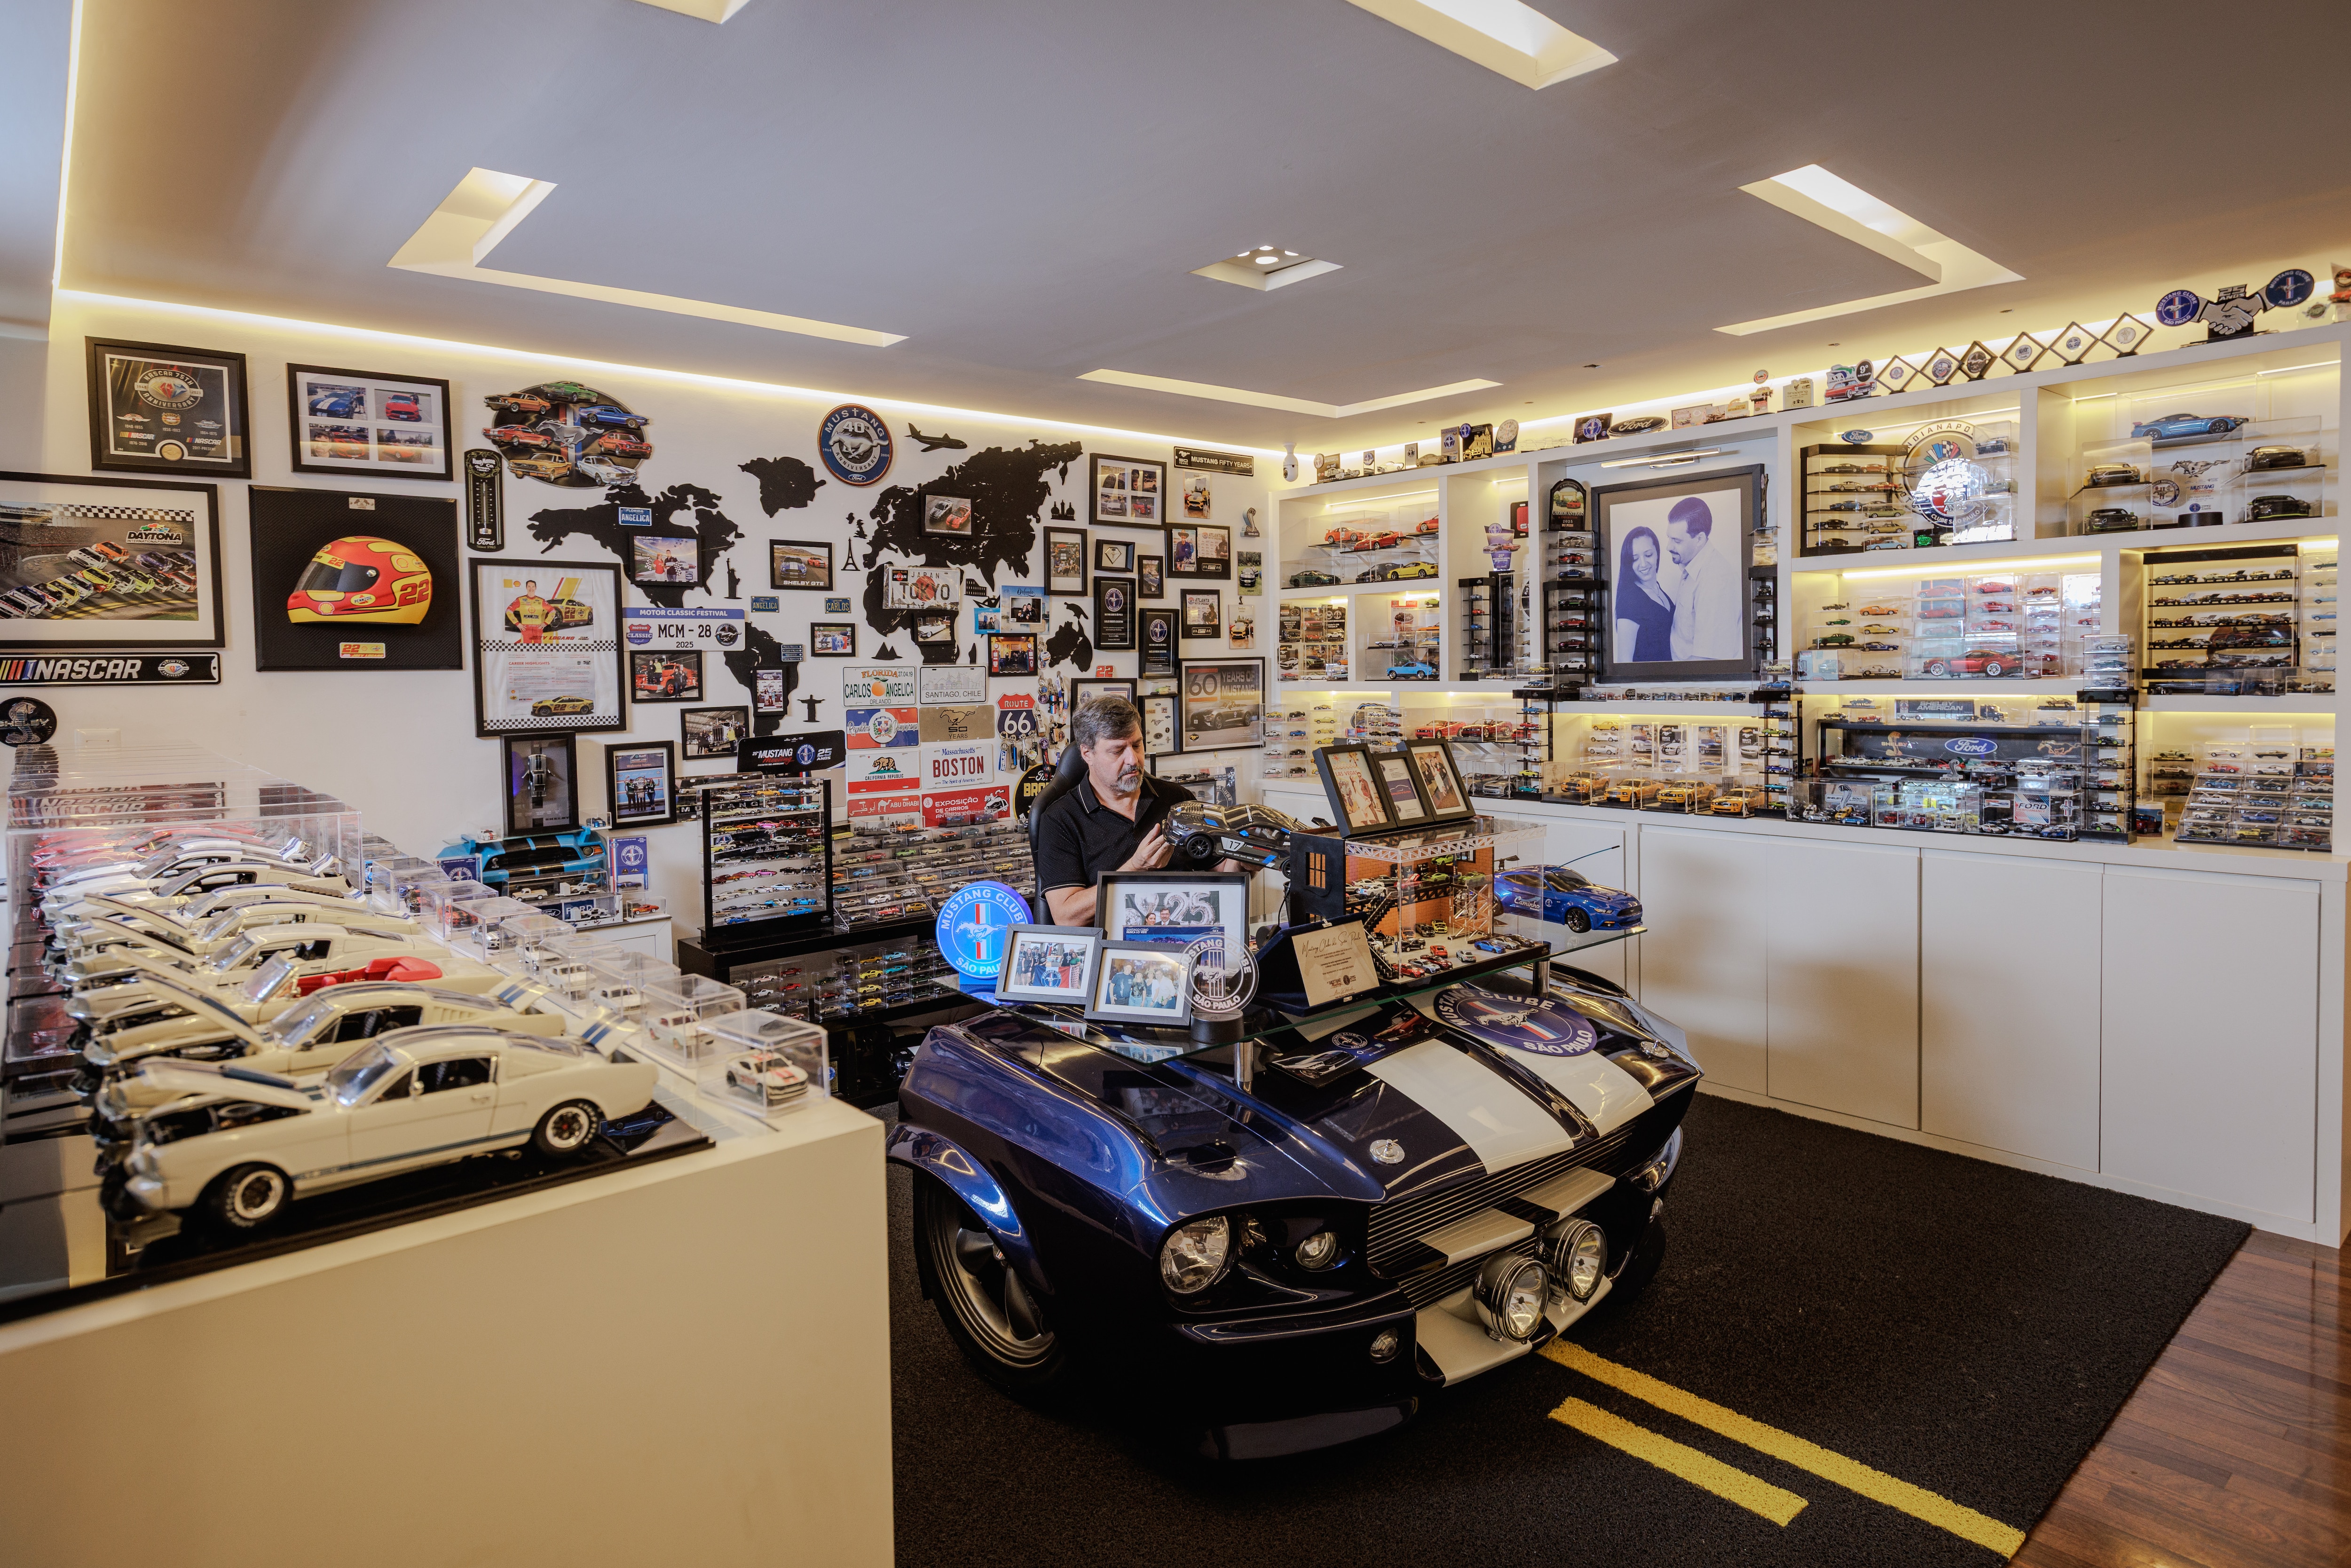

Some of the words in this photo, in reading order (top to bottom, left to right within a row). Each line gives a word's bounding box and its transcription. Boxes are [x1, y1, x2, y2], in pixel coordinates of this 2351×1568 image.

[2270, 271, 2294, 289] MUSTANG
[2295, 271, 2311, 283] CLUBE
[2219, 285, 2246, 297] 25
[2159, 291, 2181, 311] MUSTANG
[2182, 292, 2198, 305] CLUBE
[2175, 315, 2191, 324] PAULO
[144, 370, 173, 381] NASCAR
[175, 372, 194, 385] 75TH
[142, 393, 195, 408] ANNIVERSARY
[825, 409, 884, 438] MUSTANG
[843, 421, 865, 433] 40
[1618, 418, 1653, 431] Ford
[1850, 431, 1869, 441] Ford
[836, 451, 878, 471] ANNIVERSARY
[1191, 456, 1218, 465] MUSTANG
[1943, 489, 1966, 504] 25
[621, 514, 650, 522] ANGELICA
[1931, 513, 1948, 524] CLUBE
[1963, 510, 1980, 522] PAULO
[328, 557, 345, 567] 22
[398, 579, 430, 607] 22
[899, 582, 950, 601] TOKYO
[1017, 588, 1035, 596] Orlando
[565, 607, 576, 619] 22
[658, 624, 685, 638] MCM
[698, 624, 711, 638] 28
[341, 644, 360, 653] 22
[34, 659, 142, 680] NASCAR
[861, 670, 898, 678] FLORIDA
[1097, 666, 1113, 677] 22
[1189, 674, 1217, 696] 60
[1223, 671, 1245, 683] YEARS
[1246, 670, 1255, 681] OF
[845, 683, 871, 699] CARLOS
[886, 682, 914, 697] ANGELICA
[1223, 684, 1255, 697] MUSTANG
[0, 718, 49, 727] SHELBY
[848, 721, 870, 736] República
[893, 719, 917, 733] Dominicana
[1004, 711, 1031, 734] 66
[797, 744, 807, 754] MUSTANG
[1954, 739, 1989, 752] Ford
[758, 748, 793, 758] MUSTANG
[817, 748, 832, 757] 25
[933, 756, 984, 778] BOSTON
[935, 797, 978, 807] EXPOSIÇÃO
[849, 804, 868, 816] ظبي
[623, 846, 634, 856] MUSTANG
[941, 889, 991, 930] MUSTANG
[1165, 892, 1216, 925] 25
[1514, 896, 1540, 909] Caminho
[1302, 940, 1318, 957] Mustang
[1319, 938, 1331, 952] Clube
[1348, 932, 1361, 945] Paulo
[1182, 939, 1223, 971] MUSTANG
[1226, 943, 1252, 973] CLUBE
[955, 957, 977, 973] SÃO
[979, 963, 1001, 974] PAU
[1193, 994, 1211, 1008] SÃO
[1213, 995, 1240, 1009] PAULO
[1439, 989, 1475, 1026] MUSTANG
[1479, 992, 1555, 1010] CLUBE
[1523, 1041, 1563, 1053] SÃO
[1560, 1030, 1593, 1053] PAULO
